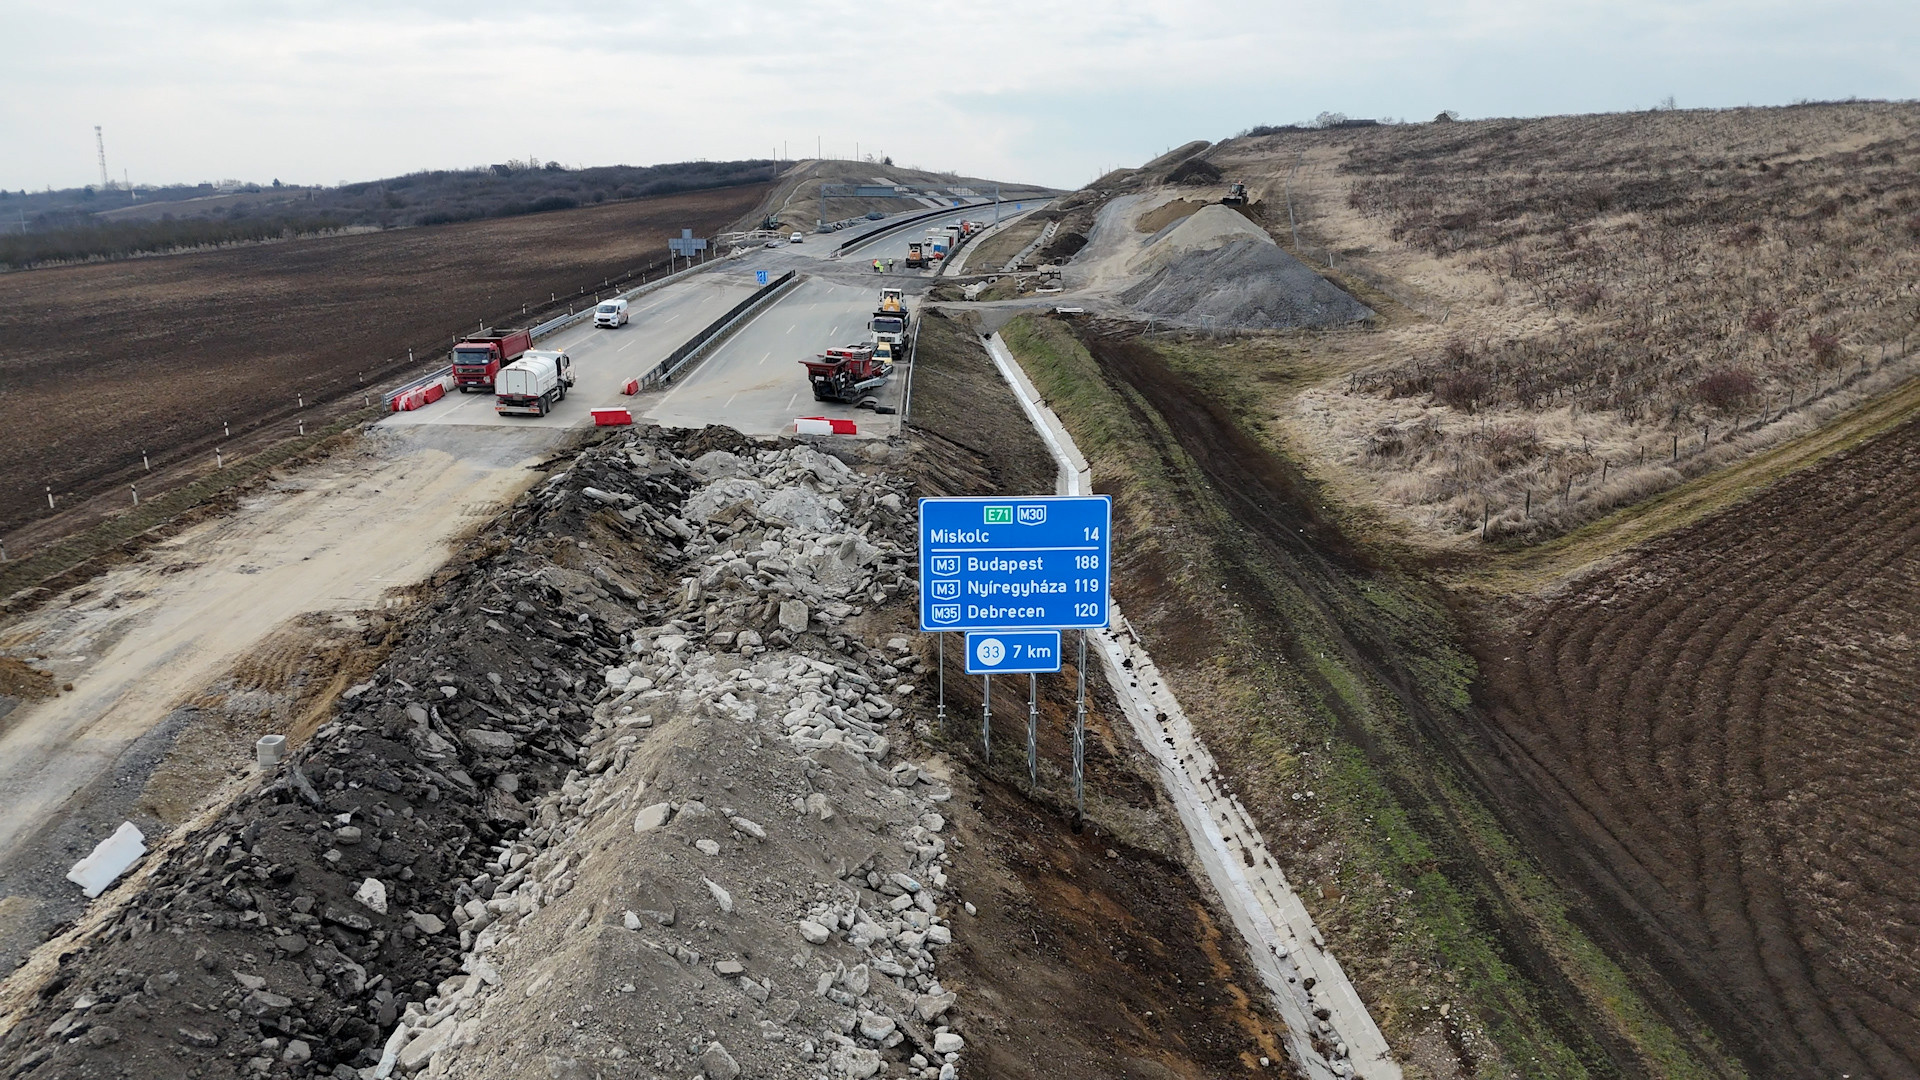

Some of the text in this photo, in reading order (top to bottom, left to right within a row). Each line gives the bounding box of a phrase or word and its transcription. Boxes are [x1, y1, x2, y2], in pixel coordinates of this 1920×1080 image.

[989, 510, 1043, 520] E71 M30
[931, 527, 1099, 543] Miskolc 14
[937, 556, 1098, 574] M3 Budapest 188
[937, 579, 1098, 597] M3 Nyíregyháza 119
[935, 603, 1098, 618] M35 Debrecen 120
[983, 645, 1050, 658] 33 7 km
